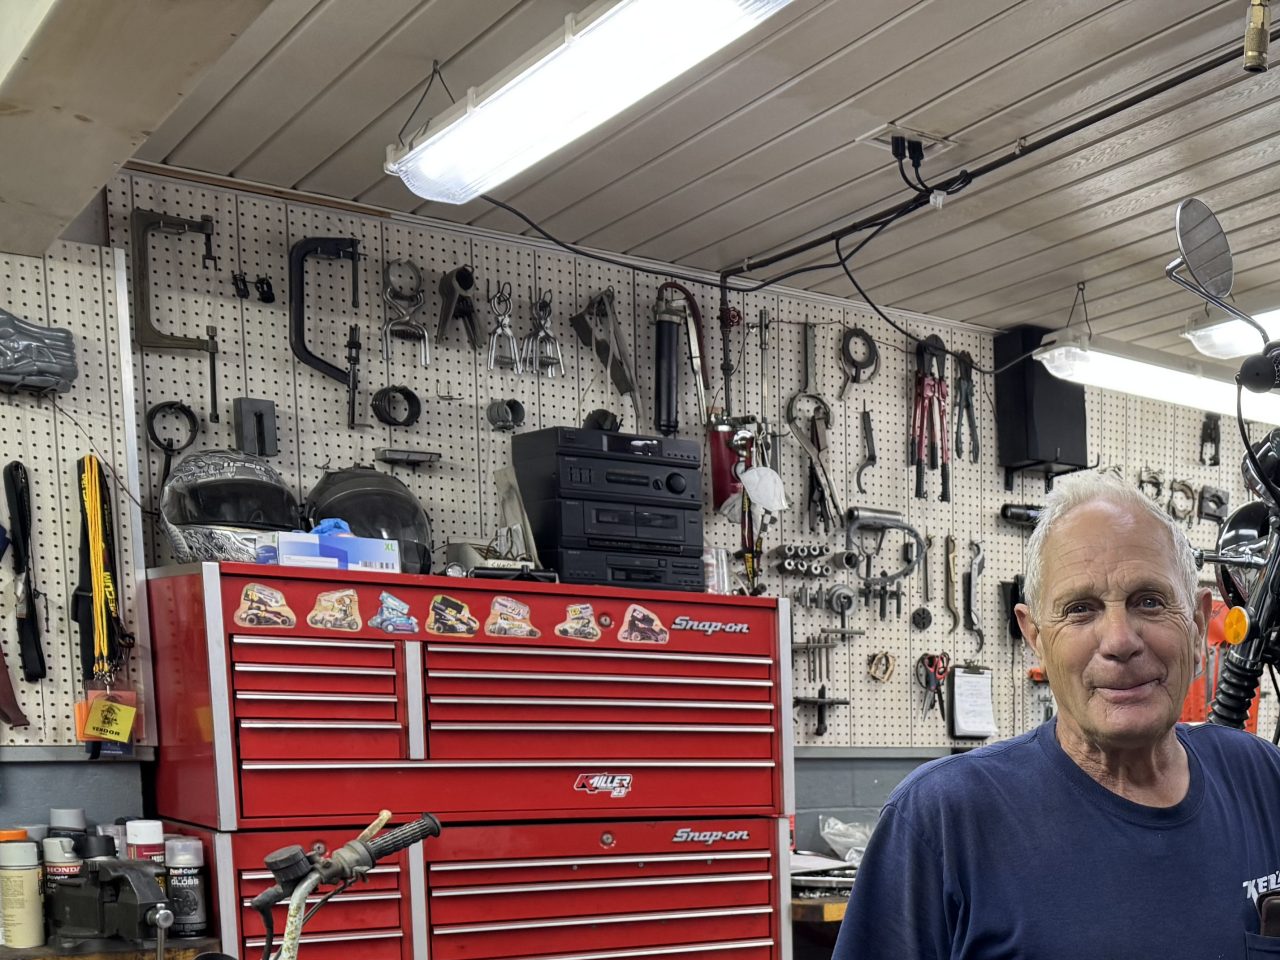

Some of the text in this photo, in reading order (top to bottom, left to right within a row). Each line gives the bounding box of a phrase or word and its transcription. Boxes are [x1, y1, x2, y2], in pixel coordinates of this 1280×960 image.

[384, 542, 396, 552] XL
[672, 616, 750, 637] Snap-on
[92, 726, 120, 736] VENDOR
[672, 828, 750, 845] Snap-on
